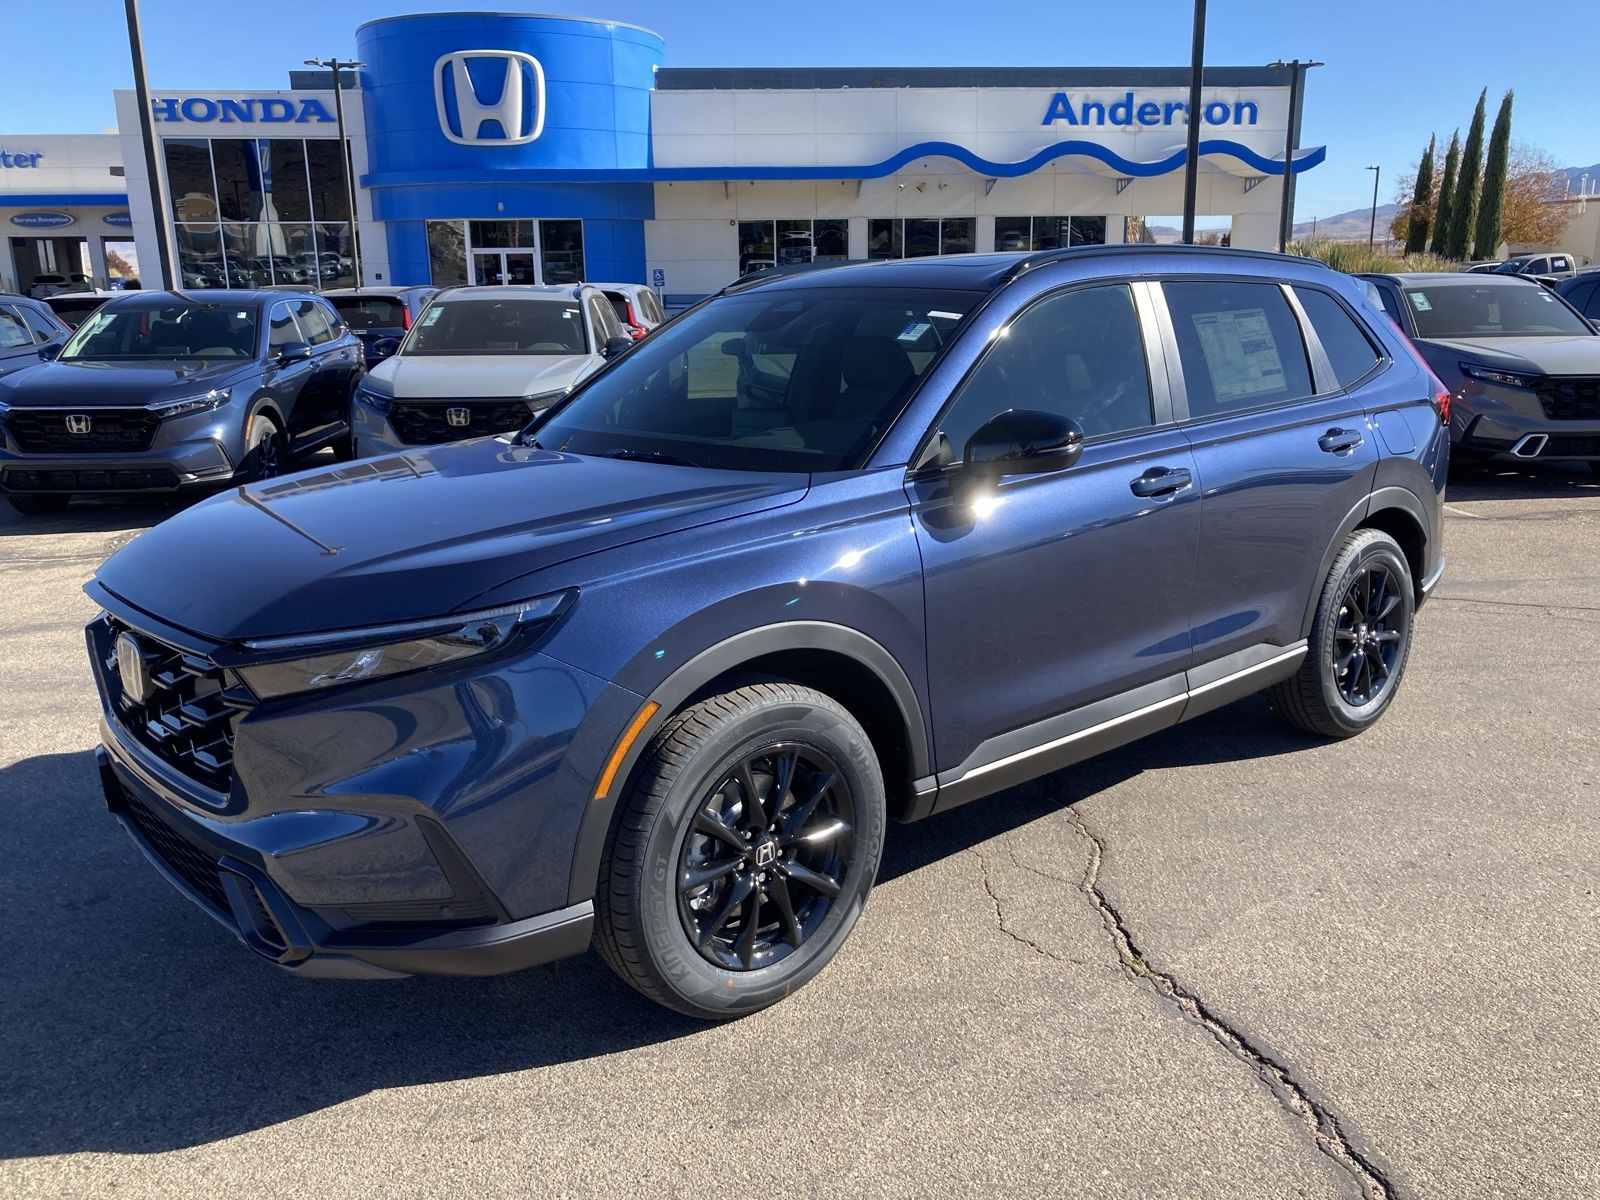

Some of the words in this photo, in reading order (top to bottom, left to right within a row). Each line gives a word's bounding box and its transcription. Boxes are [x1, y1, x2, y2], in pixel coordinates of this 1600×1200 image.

[151, 97, 337, 123] HONDA
[38, 216, 69, 224] Reception
[486, 231, 533, 239] WELCOM
[654, 853, 667, 882] GT
